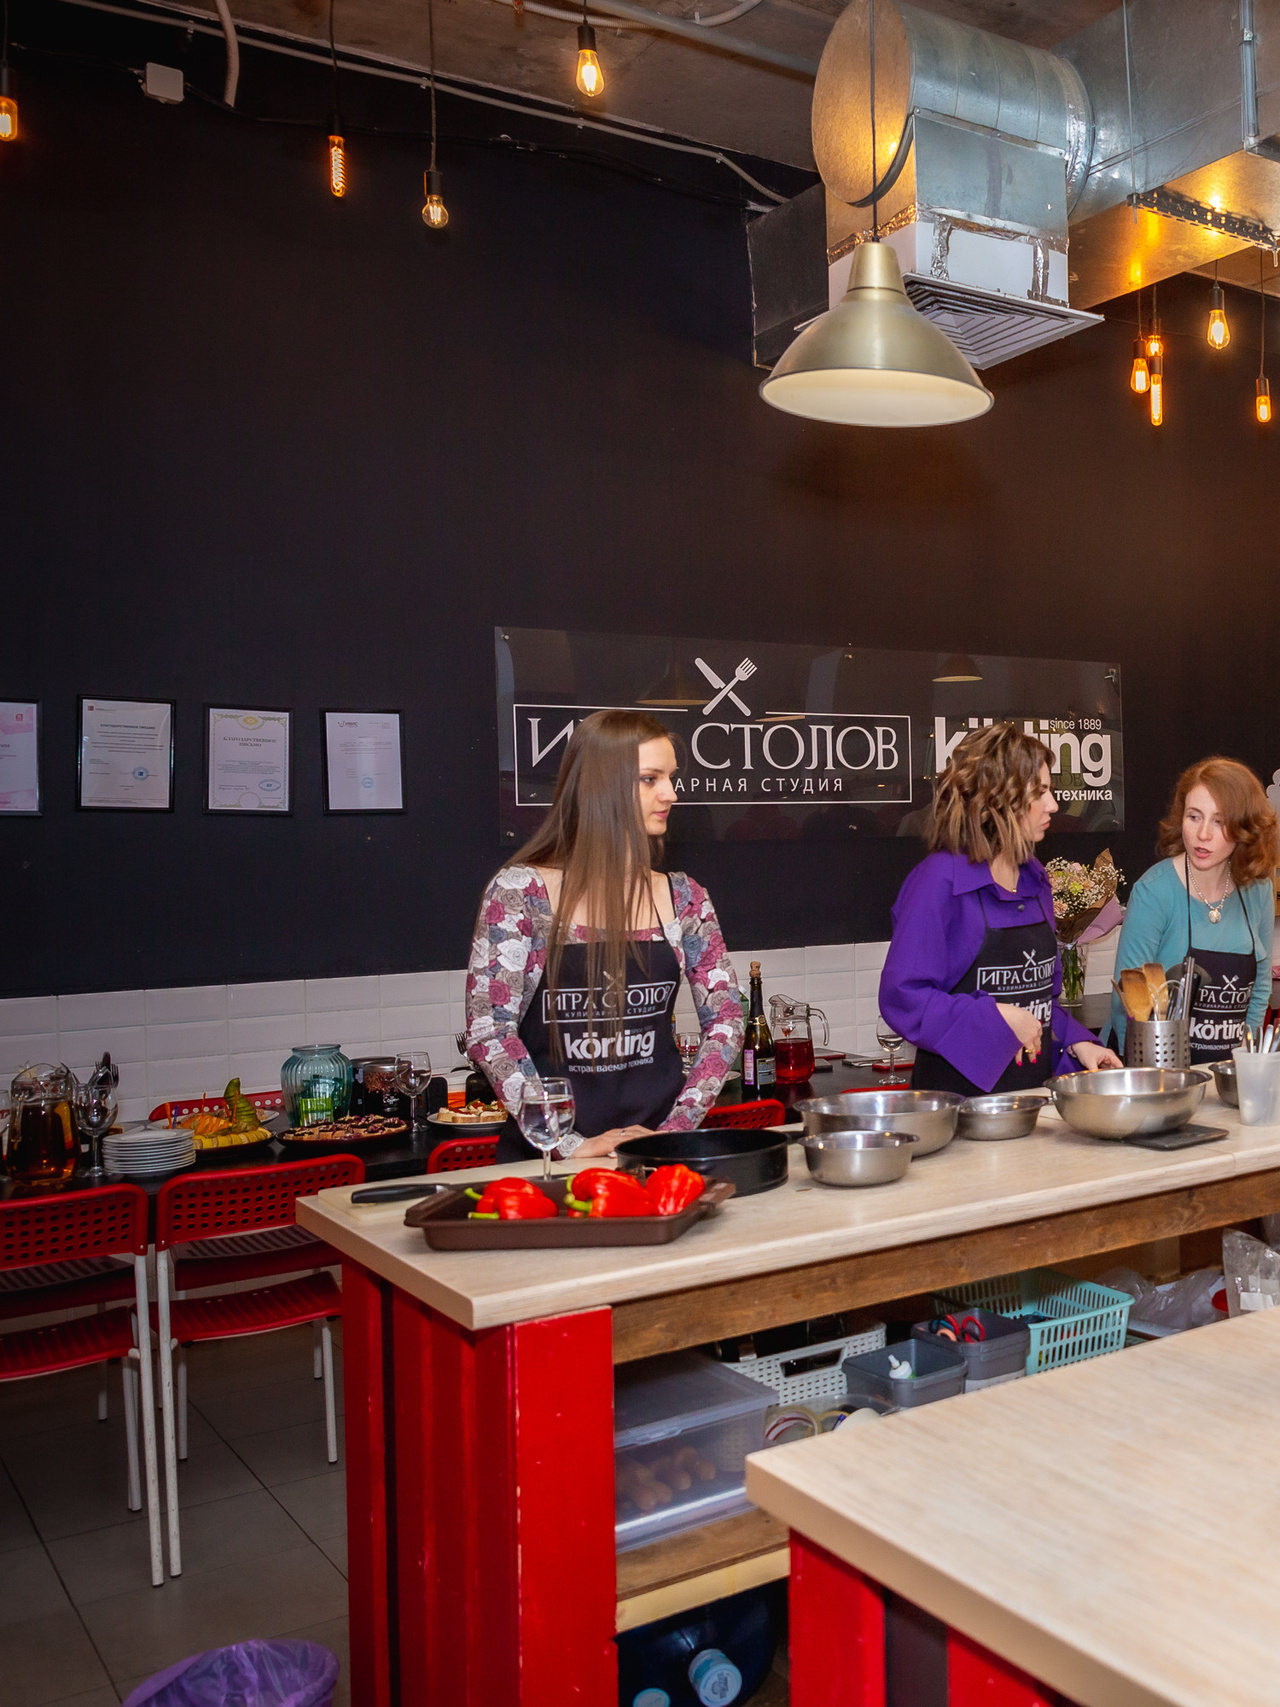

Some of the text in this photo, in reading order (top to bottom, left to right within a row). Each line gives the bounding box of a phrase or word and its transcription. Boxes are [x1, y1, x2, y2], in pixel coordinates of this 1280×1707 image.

[1050, 718, 1102, 730] since 1889
[691, 722, 899, 770] СТОЛОВ
[674, 777, 843, 794] АРНАЯ СТУДИЯ
[1054, 789, 1113, 801] техника
[982, 970, 1021, 985] ИГРА
[547, 992, 598, 1011] ИГРА
[1189, 1017, 1246, 1041] körting
[563, 1029, 656, 1060] körting
